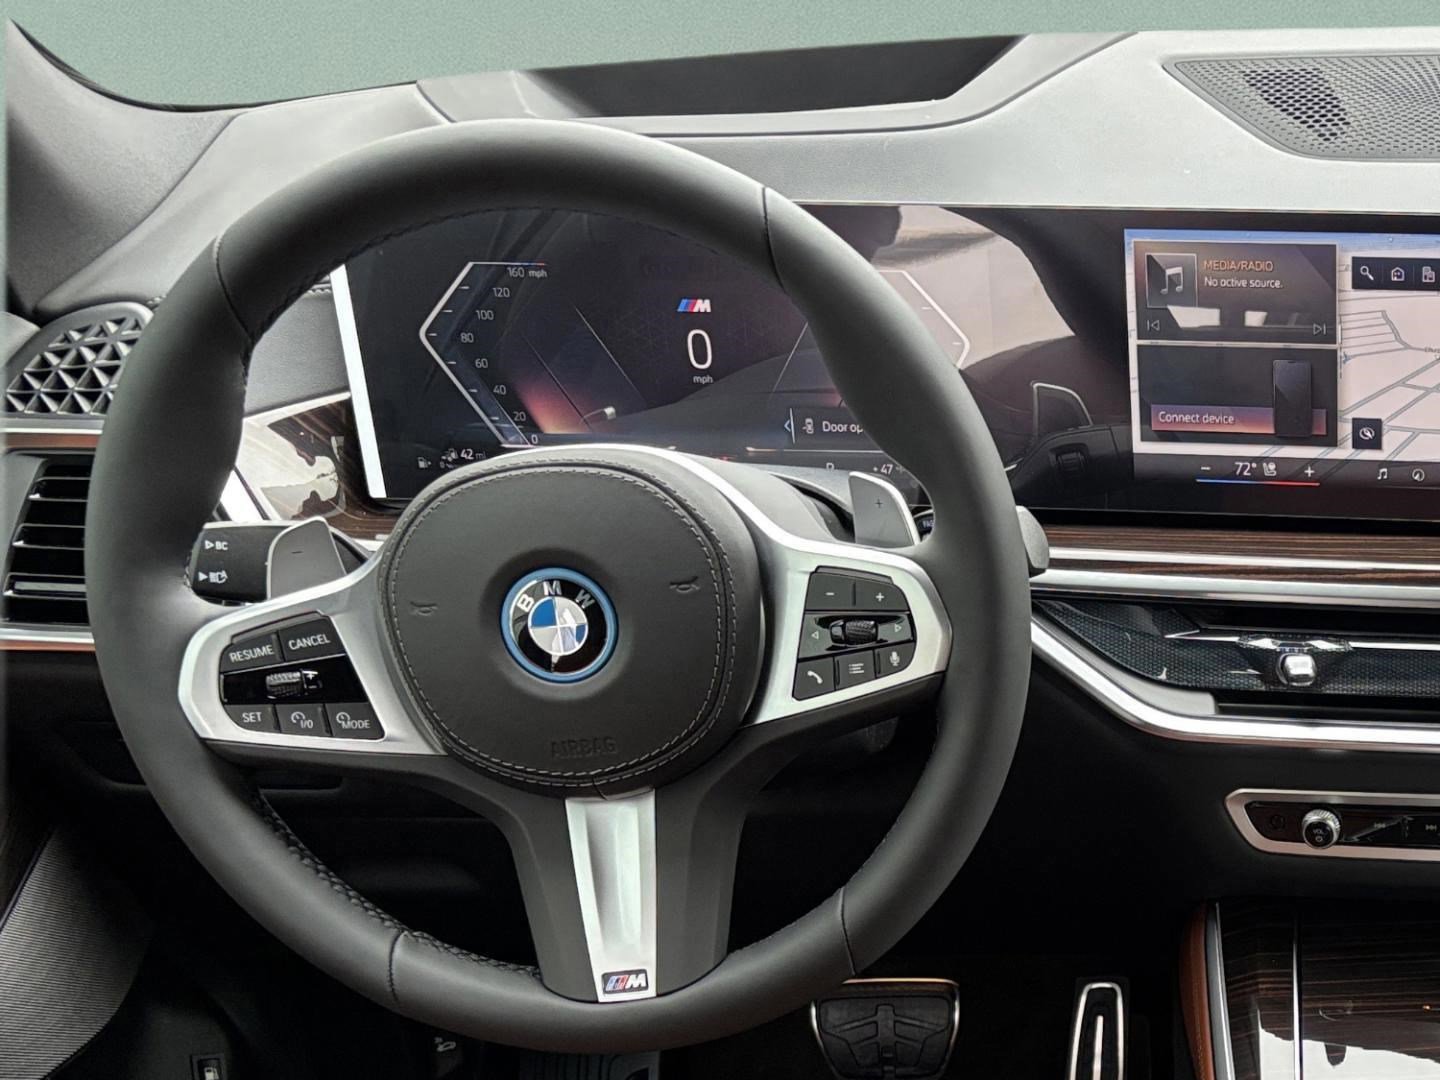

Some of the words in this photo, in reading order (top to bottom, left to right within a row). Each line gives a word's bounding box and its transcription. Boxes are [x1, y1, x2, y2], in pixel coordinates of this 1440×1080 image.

[1203, 260, 1274, 272] MEDIA/RADIO
[507, 267, 525, 277] 160
[529, 270, 547, 278] mph
[1204, 276, 1218, 287] No
[1220, 277, 1247, 288] active
[1249, 279, 1284, 288] source.
[493, 288, 510, 298] 120
[476, 310, 494, 320] 100
[461, 333, 474, 343] 80
[687, 329, 713, 370] 0
[475, 358, 488, 368] 60
[693, 375, 713, 384] mph
[493, 385, 507, 395] 40
[514, 412, 526, 421] 20
[1158, 411, 1200, 423] Connect
[1202, 412, 1235, 424] device
[822, 420, 847, 432] Door
[531, 434, 538, 444] 0
[460, 448, 474, 460] 42
[215, 541, 228, 550] BC
[516, 579, 595, 613] BMW
[288, 633, 331, 650] CANCEL
[229, 644, 275, 663] RESUME
[242, 711, 262, 723] SET
[341, 719, 370, 730] MODE
